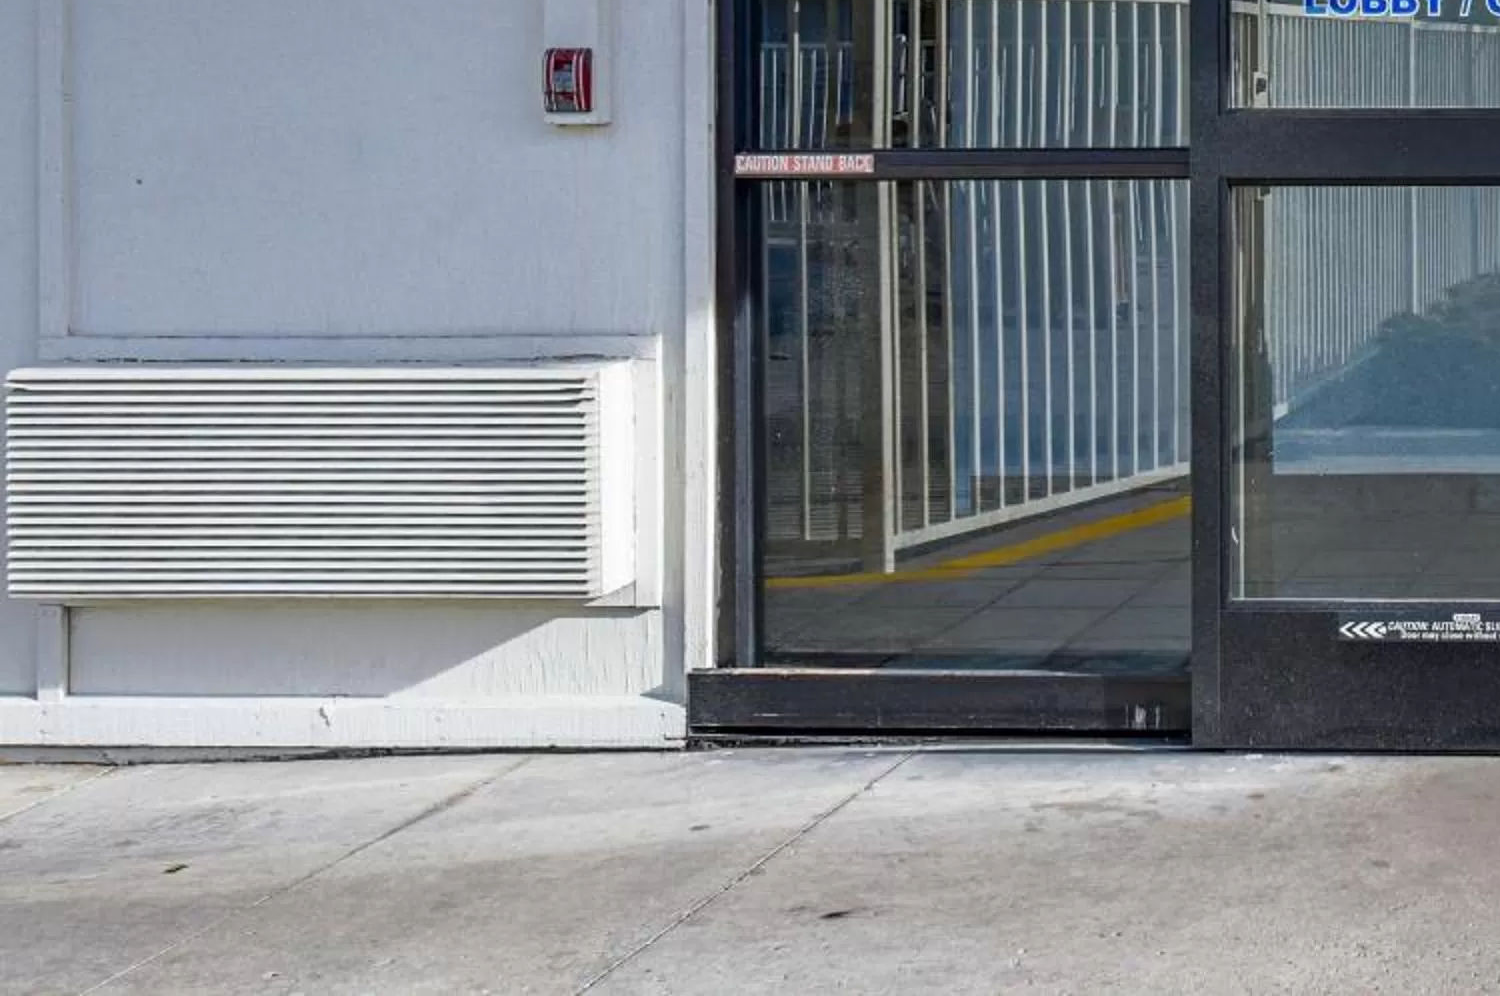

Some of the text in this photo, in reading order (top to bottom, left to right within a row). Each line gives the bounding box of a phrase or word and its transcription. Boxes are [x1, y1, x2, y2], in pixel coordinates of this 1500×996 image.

[736, 155, 874, 173] CAUTION STAND BACK
